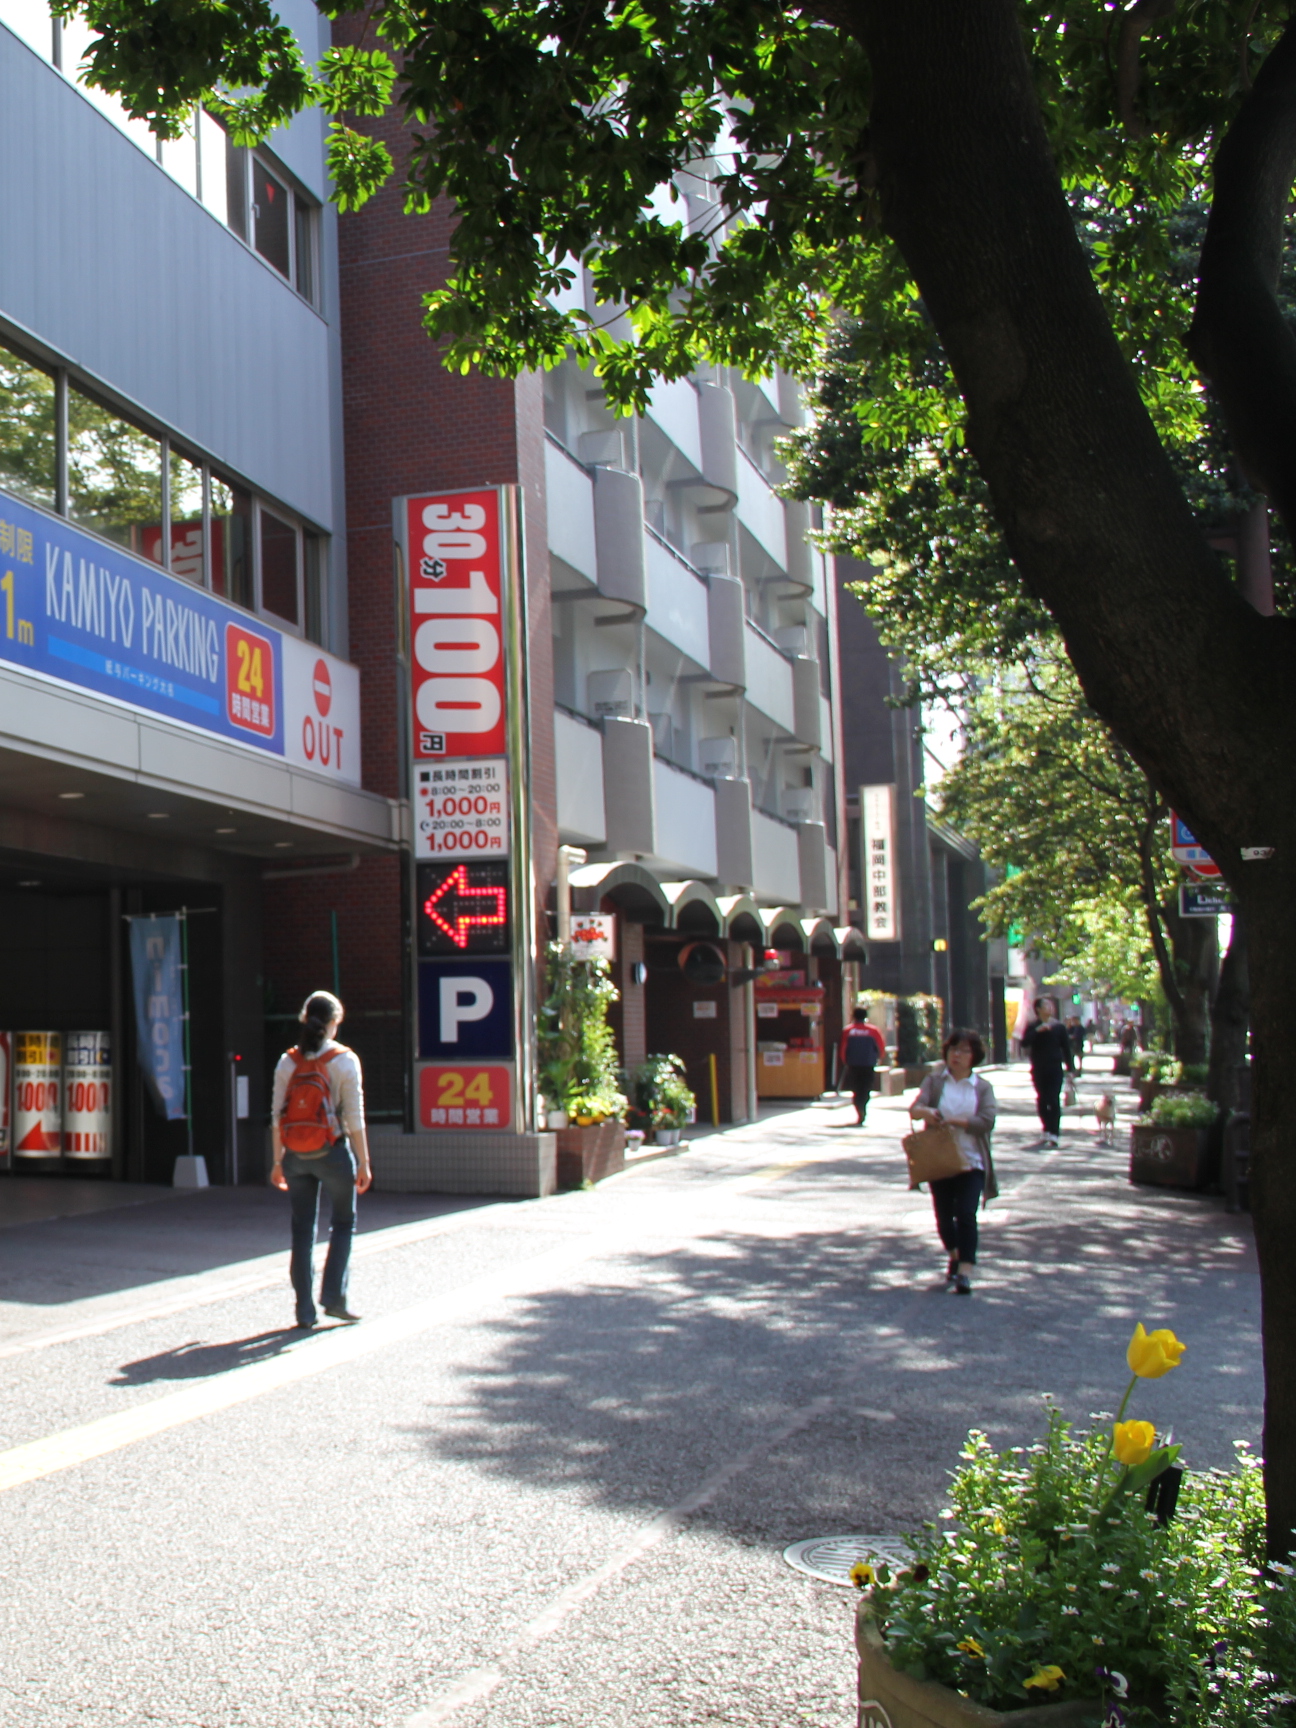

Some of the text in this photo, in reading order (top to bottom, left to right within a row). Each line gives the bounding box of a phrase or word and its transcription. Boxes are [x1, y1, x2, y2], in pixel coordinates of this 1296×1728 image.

[46, 542, 220, 683] KAMIYO PARKING
[236, 639, 264, 698] 24
[232, 692, 270, 728] 時間営業
[302, 715, 344, 770] OUT
[425, 796, 501, 818] 1,000円
[426, 830, 502, 852] 1,000円
[872, 839, 887, 929] 福岡中部教会
[439, 976, 494, 1043] P
[437, 1072, 494, 1106] 24
[431, 1107, 499, 1125] 時間営業
